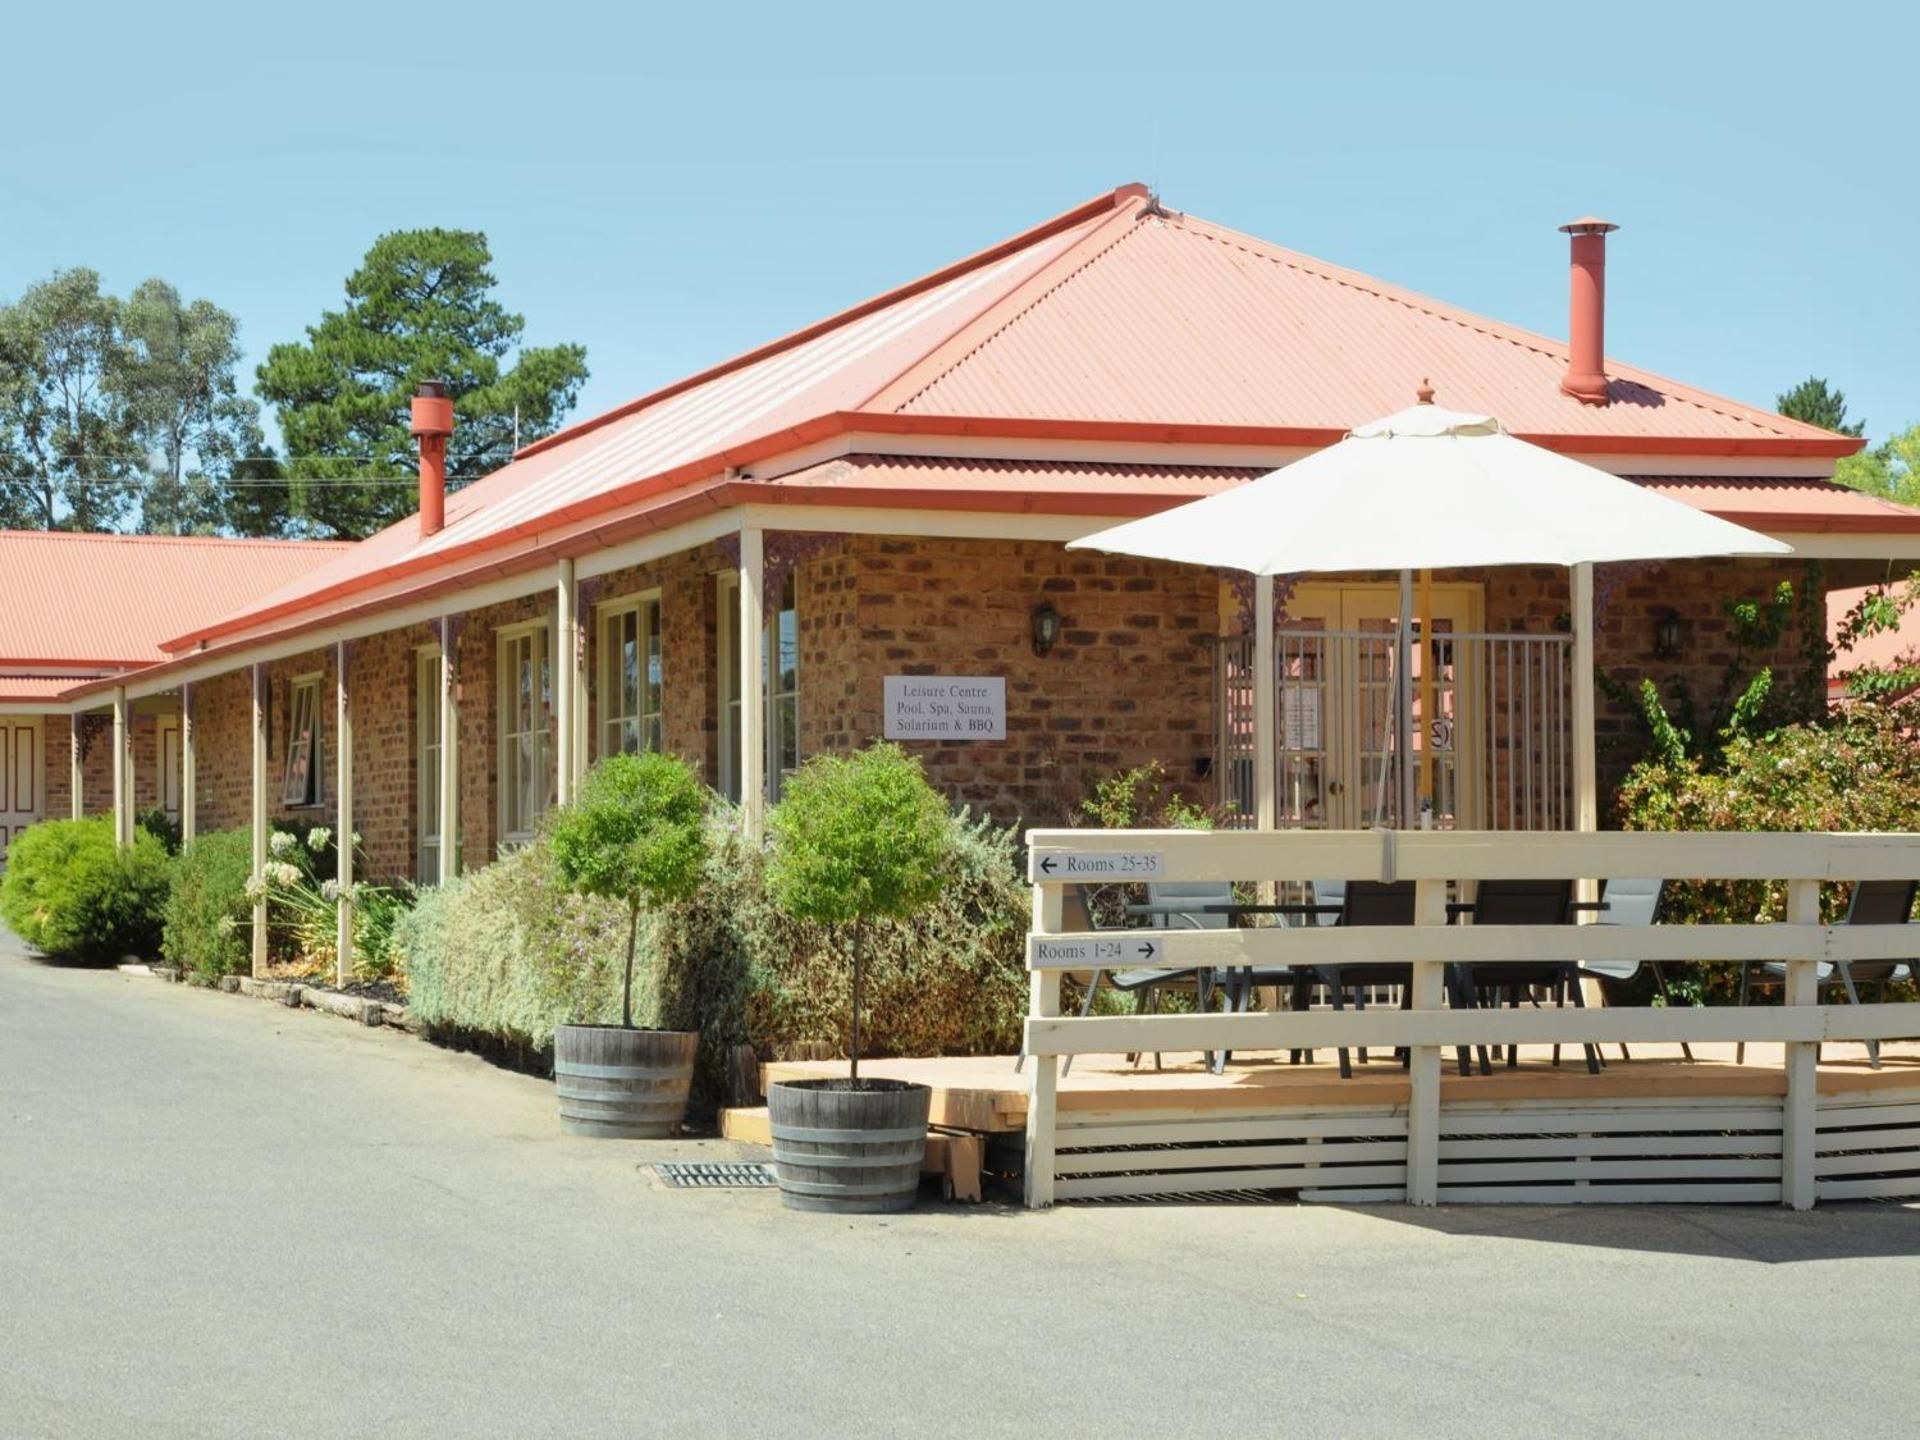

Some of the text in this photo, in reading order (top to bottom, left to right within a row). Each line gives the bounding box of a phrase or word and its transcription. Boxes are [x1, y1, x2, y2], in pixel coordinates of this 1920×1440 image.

[903, 684, 988, 697] Leisure Centre
[896, 718, 993, 733] Solarium & BBQ
[1067, 856, 1157, 872] Rooms 25-35
[1038, 943, 1121, 959] Rooms 1-24
